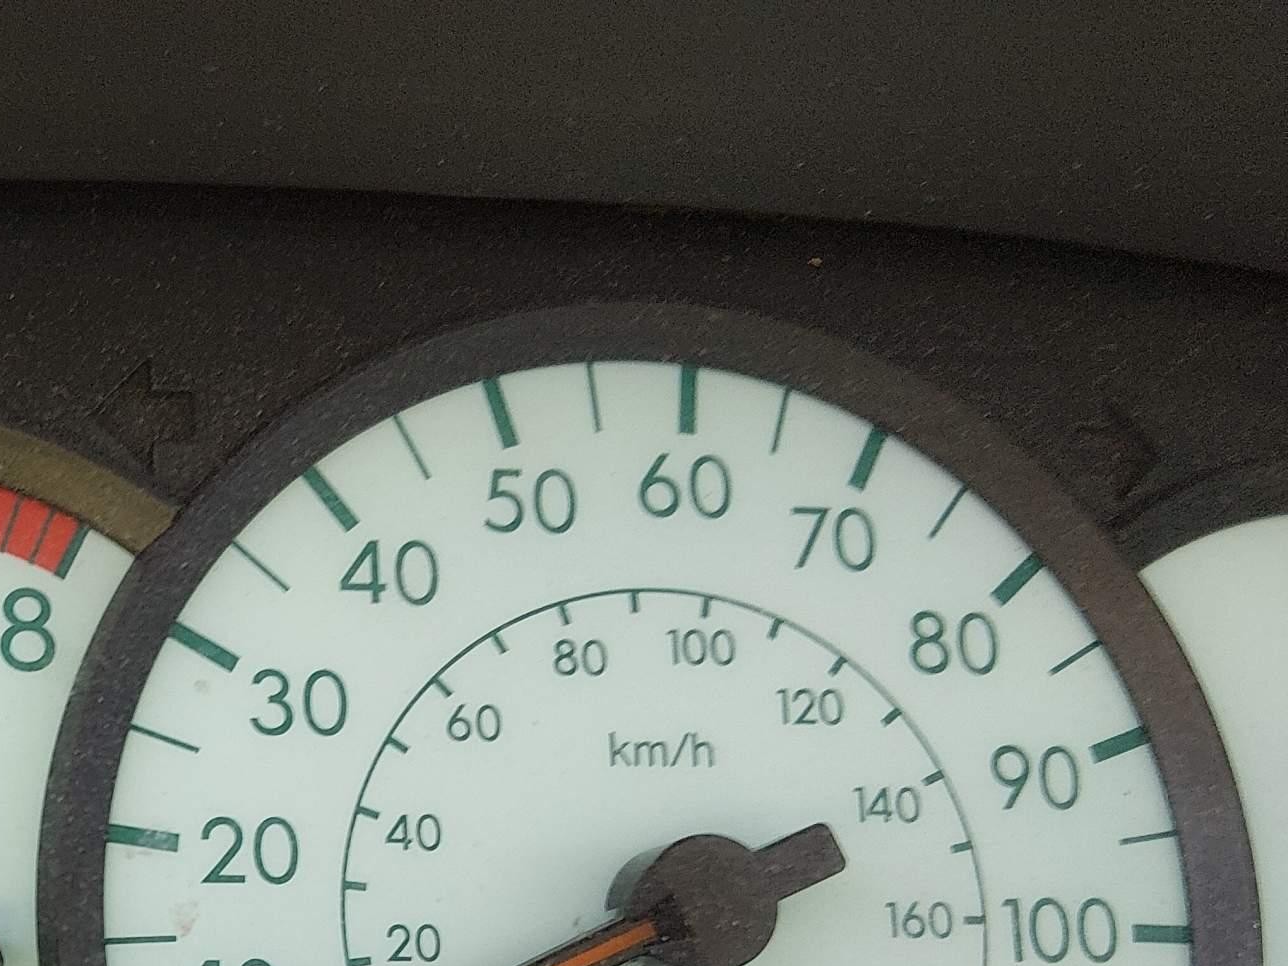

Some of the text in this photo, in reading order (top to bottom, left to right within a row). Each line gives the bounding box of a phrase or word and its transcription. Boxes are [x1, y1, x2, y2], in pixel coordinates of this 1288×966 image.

[483, 468, 578, 535] 50
[640, 453, 731, 519] 60
[790, 507, 876, 572] 70
[340, 539, 440, 607] 40
[0, 588, 56, 673] 8
[552, 638, 609, 677] 80
[666, 628, 737, 667] 100
[910, 610, 998, 676] 80
[249, 668, 349, 737] 30
[446, 703, 502, 742] 60
[775, 687, 845, 728] 120
[608, 731, 716, 769] km/h
[991, 744, 1081, 811] 90
[385, 813, 442, 852] 40
[852, 785, 921, 824] 140
[200, 815, 300, 886] 20
[385, 923, 441, 963] 20
[884, 901, 954, 940] 160
[1001, 897, 1119, 964] 100
